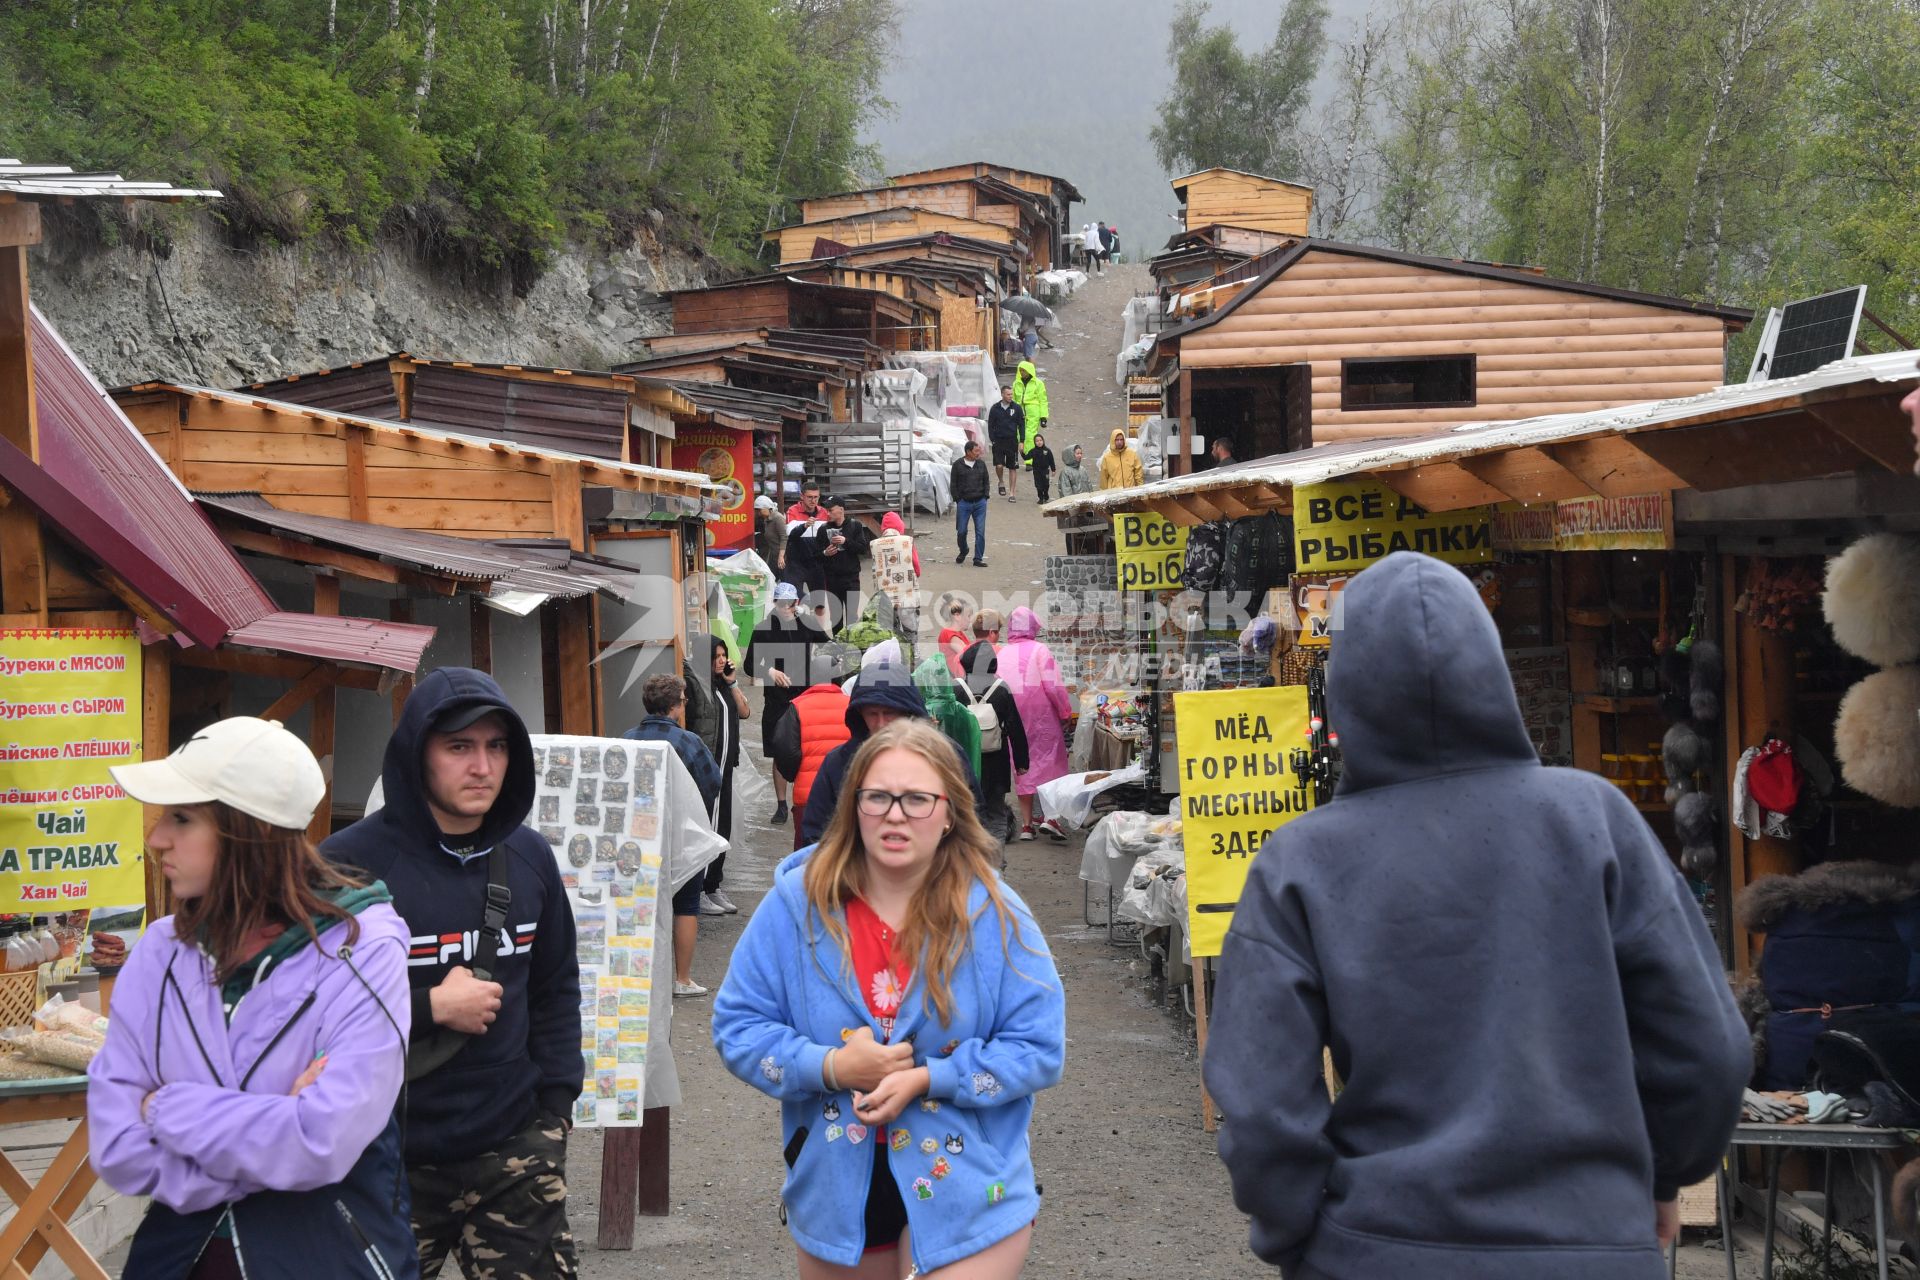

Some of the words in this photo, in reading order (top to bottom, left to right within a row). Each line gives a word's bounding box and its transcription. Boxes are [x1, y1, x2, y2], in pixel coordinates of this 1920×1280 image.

[1308, 489, 1385, 524] ВСЁ
[1123, 516, 1177, 547] Все
[1300, 523, 1491, 565] РЫБАЛКИ
[59, 660, 67, 671] с
[70, 656, 125, 671] МЯСОМ
[60, 703, 69, 714] с
[72, 698, 125, 714] СЫРОМ
[1215, 713, 1272, 744] МЁД
[63, 740, 130, 758] ЛЕПЁШКИ
[1185, 749, 1305, 781] ГОРНЫ
[61, 790, 69, 801] с
[72, 784, 127, 801] СЫРОМ
[1188, 788, 1308, 818] МЕСТНЫЙ
[37, 809, 86, 834] Чай
[27, 843, 119, 871] ТРАВАХ
[21, 885, 58, 900] Хан
[62, 881, 88, 898] Чай
